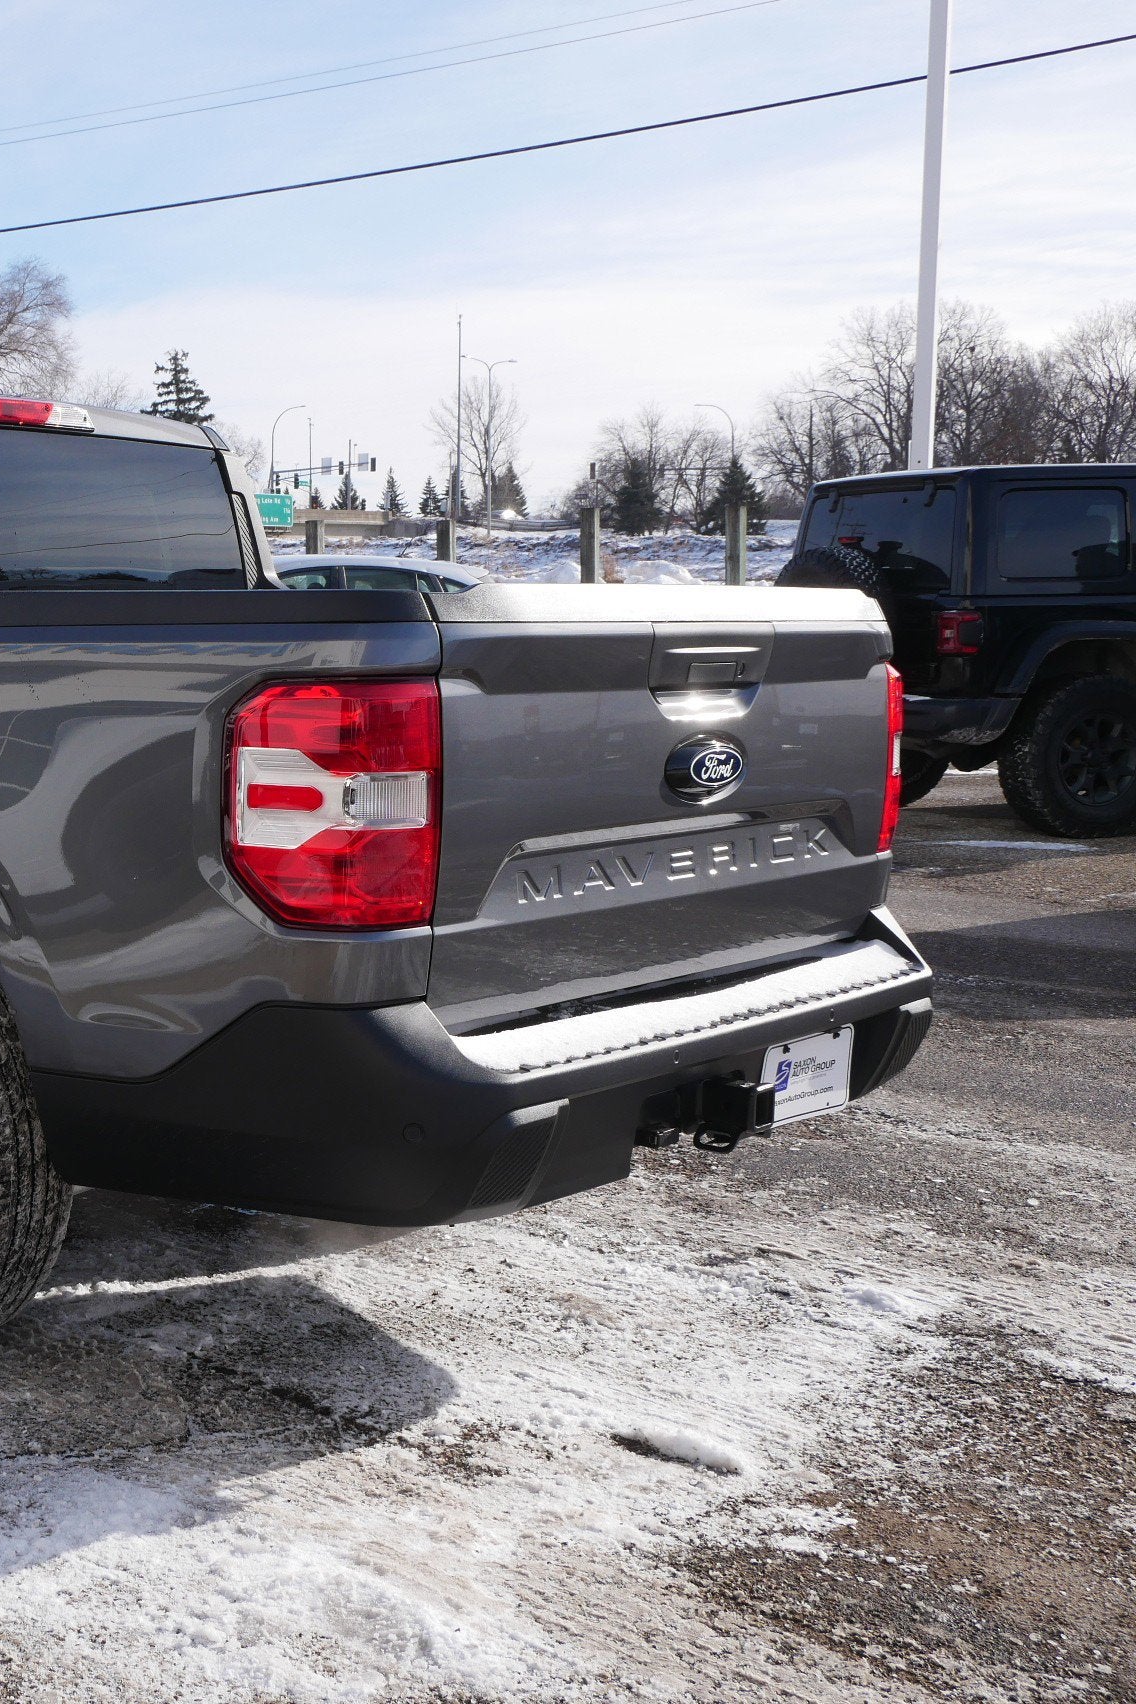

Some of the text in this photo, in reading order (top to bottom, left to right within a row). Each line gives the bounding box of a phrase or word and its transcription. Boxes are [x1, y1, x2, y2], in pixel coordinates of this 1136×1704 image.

[701, 754, 734, 779] Ford
[516, 828, 829, 904] MAVERICK
[791, 1059, 836, 1078] AUTO GROUP
[793, 1057, 816, 1070] SAXON
[775, 1086, 833, 1106] axonAutoGroup.com
